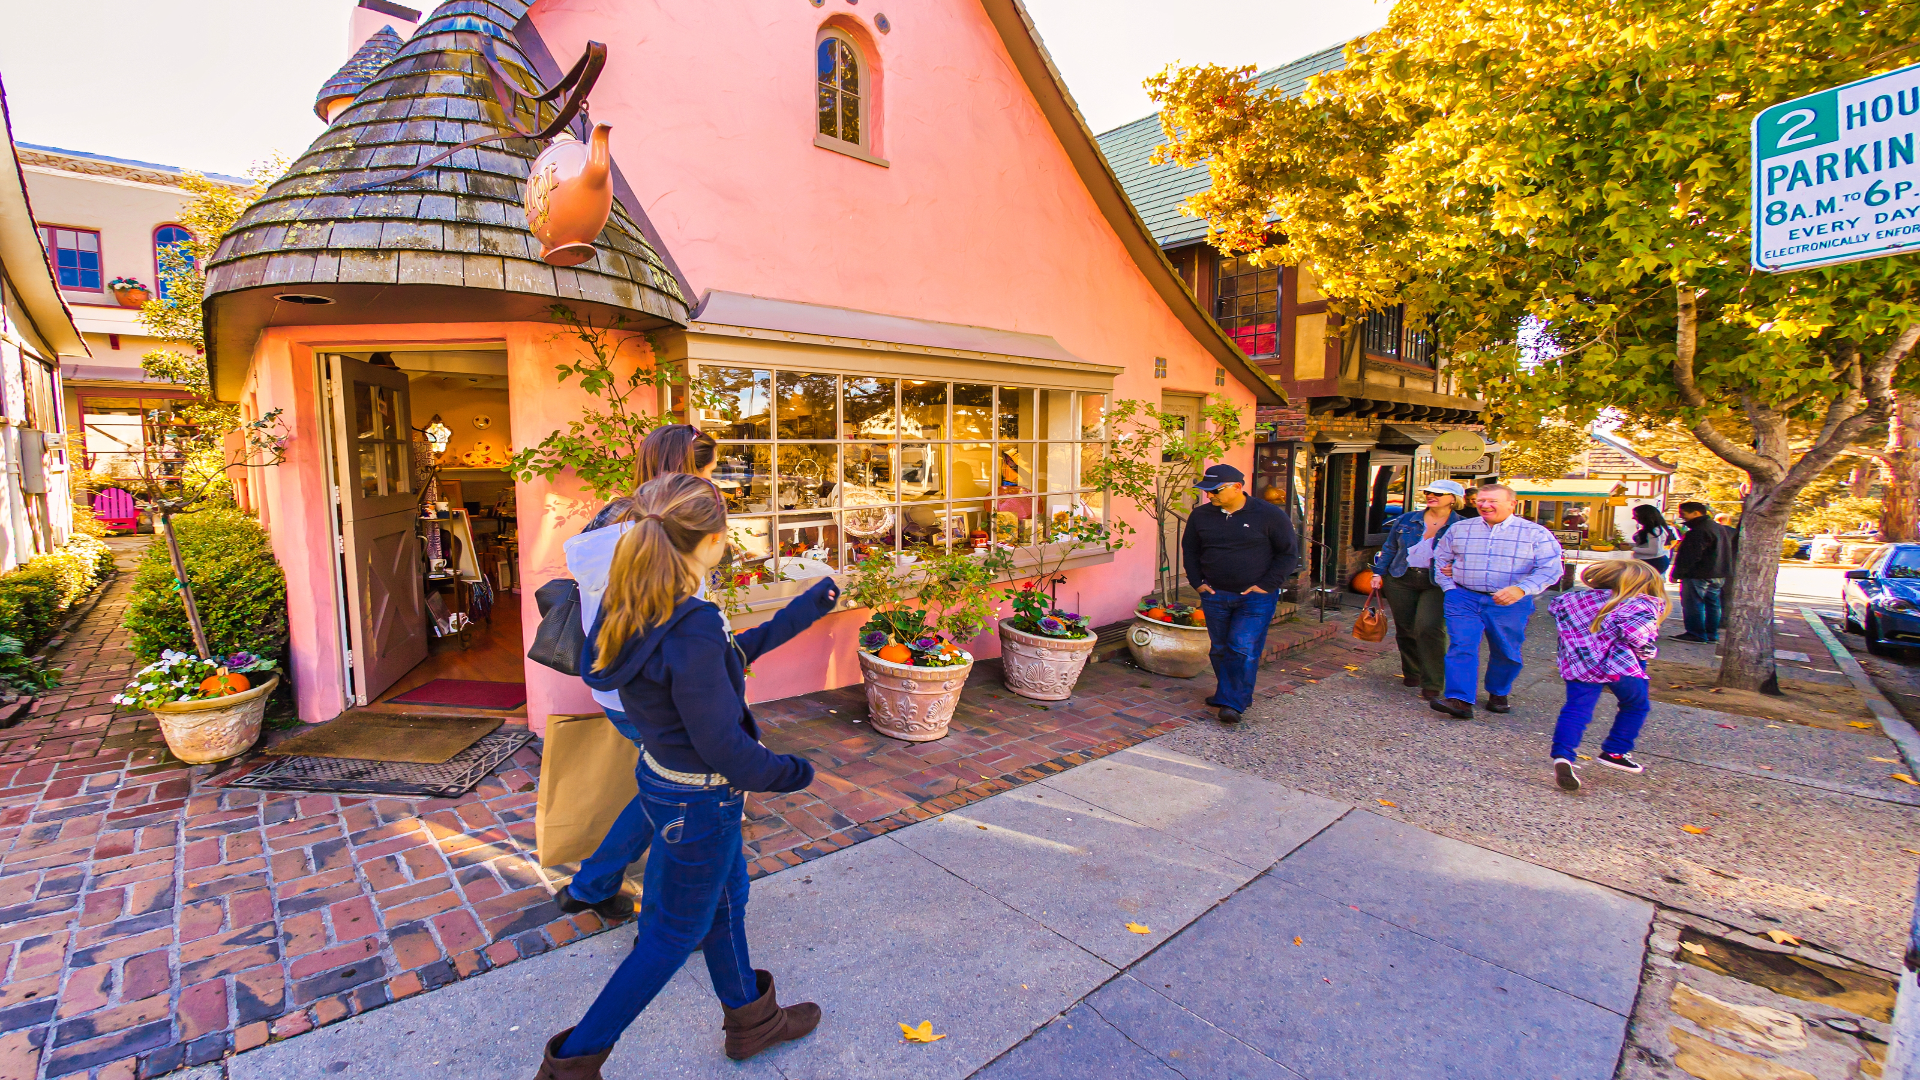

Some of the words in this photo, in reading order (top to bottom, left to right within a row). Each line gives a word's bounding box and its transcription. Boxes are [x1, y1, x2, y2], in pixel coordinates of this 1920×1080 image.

[1776, 107, 1818, 149] 2
[1767, 132, 1920, 196] PARKIN
[1843, 192, 1861, 202] TO
[1788, 216, 1861, 241] EVERY
[1874, 205, 1920, 224] DAY
[1764, 232, 1870, 259] ELECTRONICALLY
